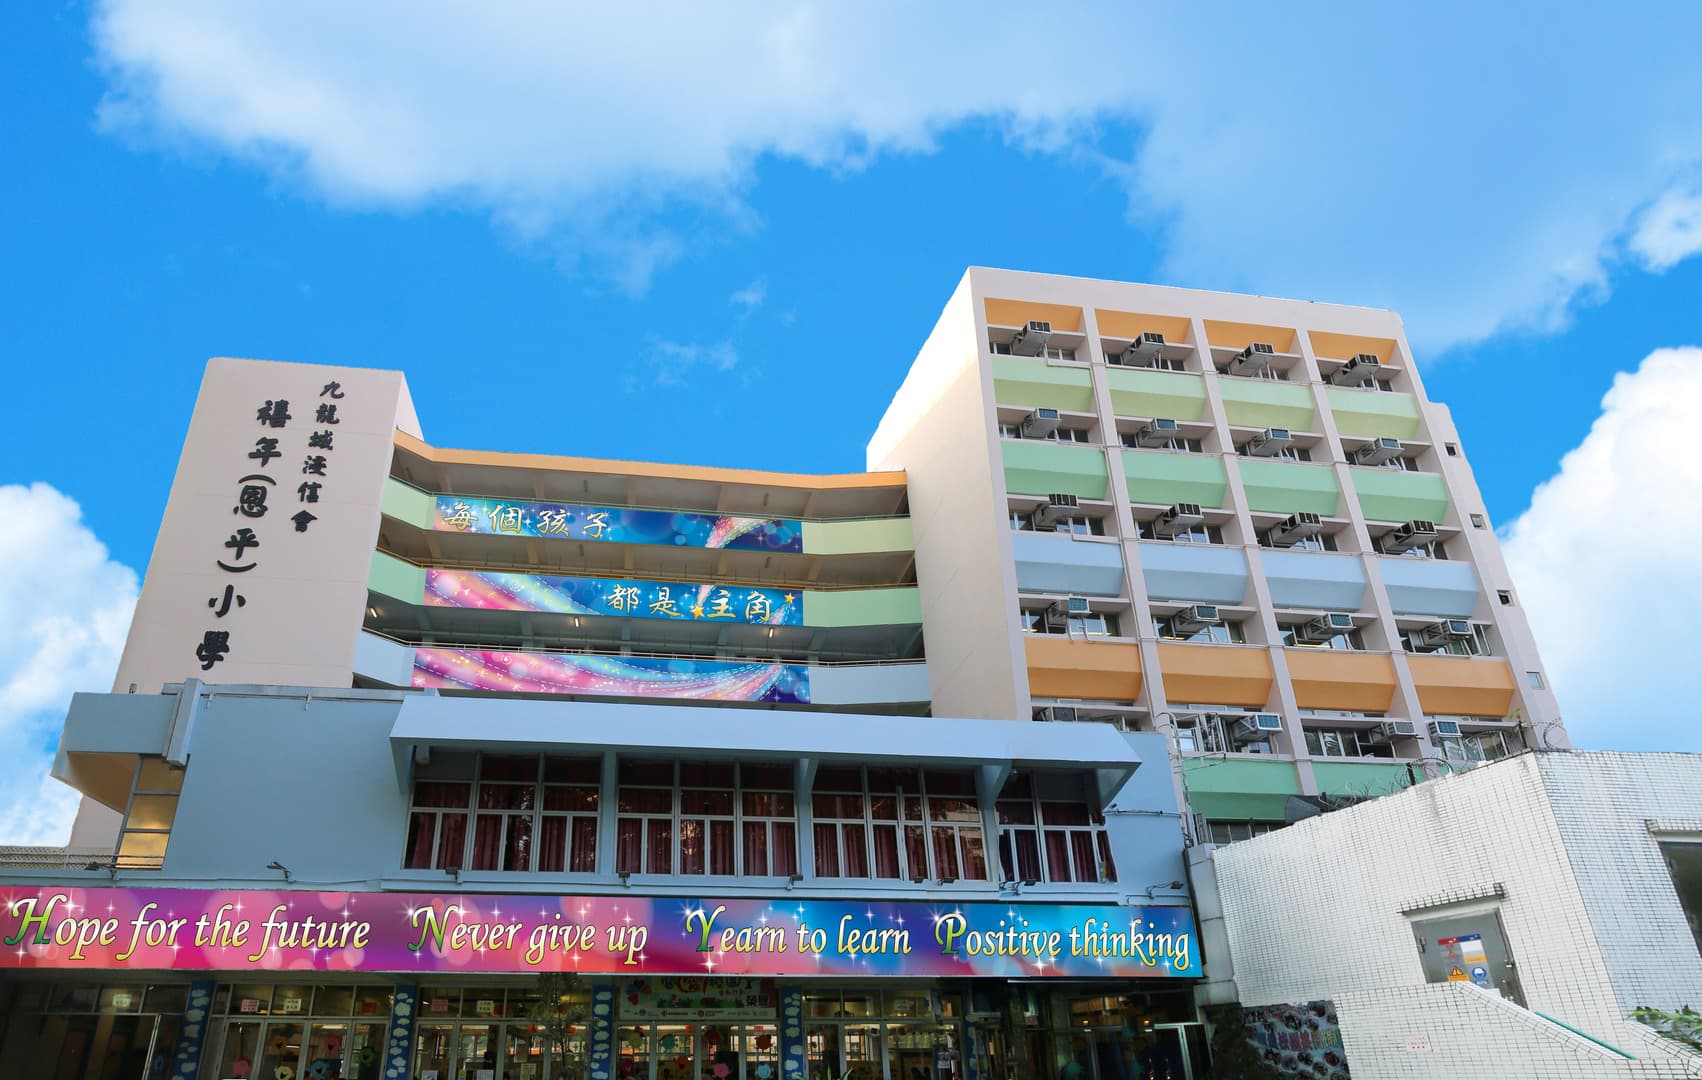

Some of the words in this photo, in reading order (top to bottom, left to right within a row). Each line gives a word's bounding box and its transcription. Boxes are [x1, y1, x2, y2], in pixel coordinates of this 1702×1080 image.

[290, 380, 345, 533] 九龍城浸信會
[442, 501, 608, 540] 每個孩子
[607, 584, 772, 623] 都是主角
[4, 894, 117, 961] Hope
[116, 903, 187, 961] for
[193, 904, 250, 948] the
[248, 903, 371, 962] future
[407, 905, 522, 954] Never
[524, 911, 595, 965] give
[606, 922, 648, 966] up
[685, 905, 788, 953] Yearn
[796, 922, 827, 953] to
[837, 914, 912, 953] learn
[934, 912, 1062, 957] Positive
[1068, 918, 1190, 971] thinking
